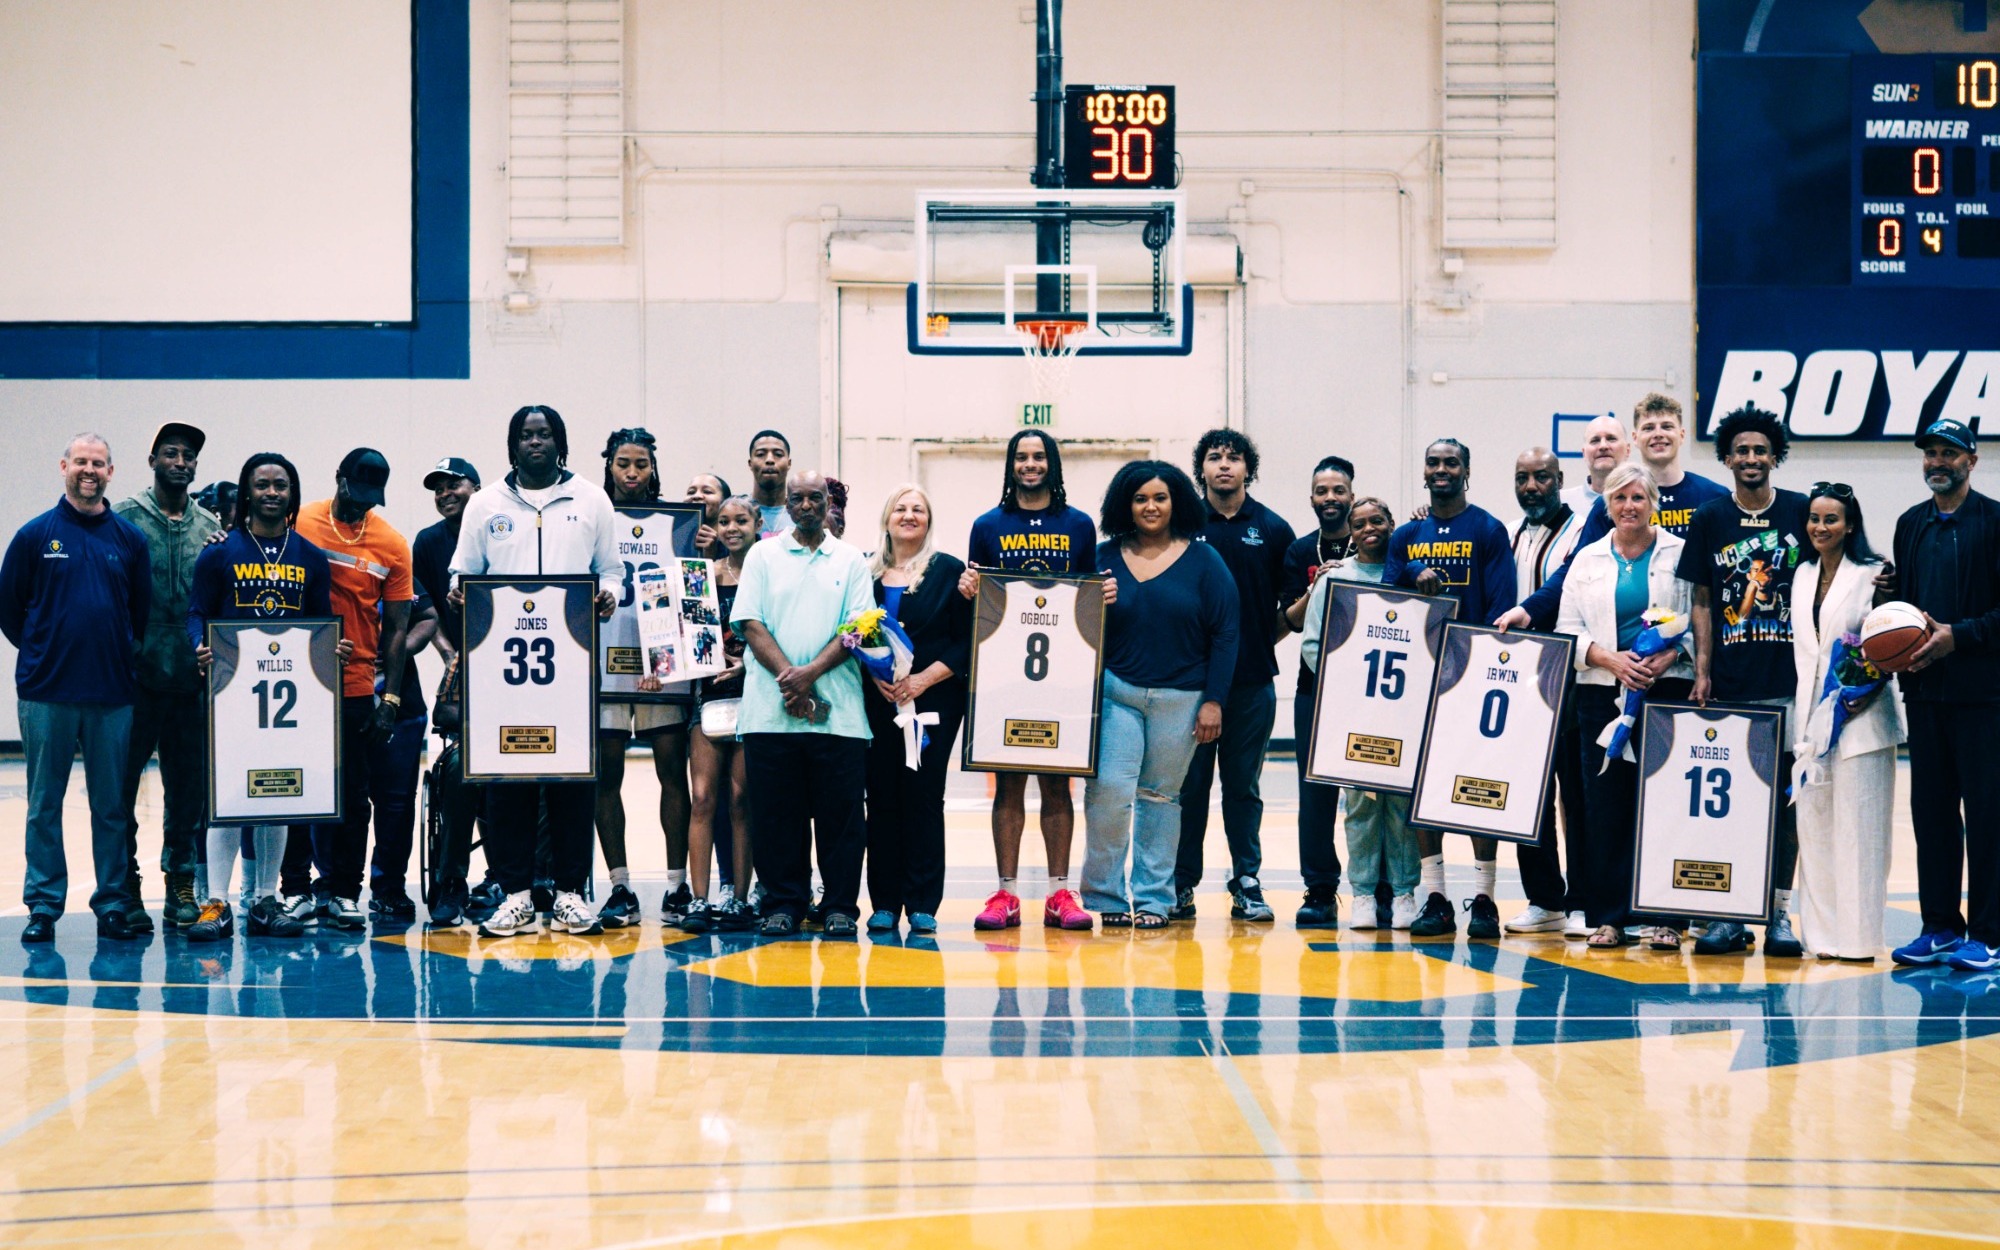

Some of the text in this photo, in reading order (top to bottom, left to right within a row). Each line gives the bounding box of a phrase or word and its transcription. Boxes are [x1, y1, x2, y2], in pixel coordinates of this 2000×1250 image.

[1959, 61, 1997, 108] 10
[1086, 93, 1166, 125] 10:00
[1865, 120, 1970, 139] WARNER
[1981, 135, 2000, 147] PE
[1092, 127, 1152, 180] 30
[1914, 148, 1939, 194] 0
[1863, 202, 1905, 215] FOULS
[1956, 203, 1989, 216] FOUL
[1916, 212, 1949, 225] T.O.L.
[1879, 219, 1900, 256] 0
[1923, 229, 1941, 253] 4
[1860, 260, 1906, 274] SCORE
[1023, 404, 1053, 426] EXIT
[1649, 508, 1696, 527] ARNE
[999, 533, 1070, 551] WARNER
[1407, 541, 1473, 560] WARNER
[999, 550, 1070, 559] BASKETBALL
[233, 562, 306, 583] WARNER
[514, 617, 548, 631] JONES
[1020, 612, 1059, 627] OGBOLU
[1367, 624, 1412, 643] RUSSELL
[1722, 618, 1748, 646] ONE
[257, 659, 293, 673] WILLIS
[503, 637, 556, 686] 33
[1024, 632, 1050, 682] 8
[1363, 648, 1408, 700] 15
[1486, 666, 1519, 684] IRWIN
[252, 680, 298, 729] 12
[1479, 689, 1509, 739] 0
[1690, 745, 1730, 761] NORRIS
[1685, 766, 1732, 818] 13
